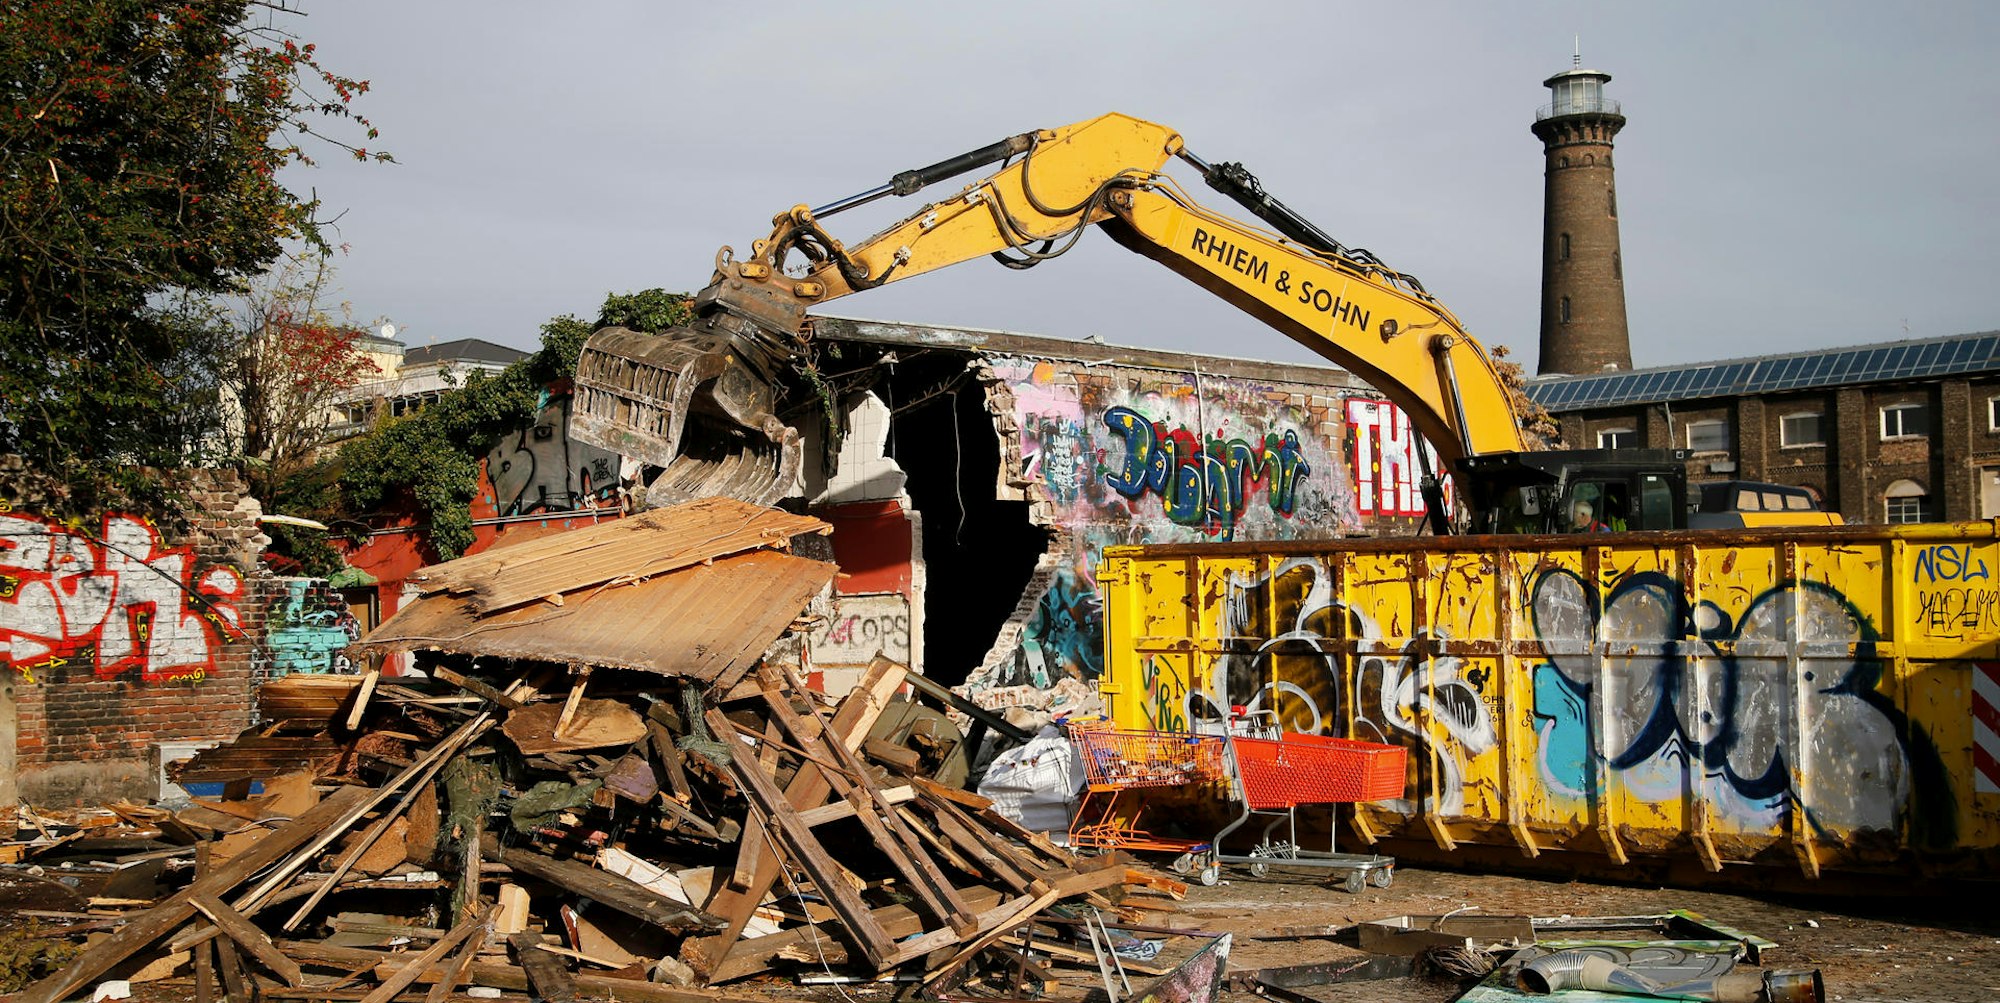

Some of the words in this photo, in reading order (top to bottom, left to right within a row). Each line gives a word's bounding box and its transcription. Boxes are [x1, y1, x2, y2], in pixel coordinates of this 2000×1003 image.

[1191, 227, 1270, 285] RHIEM
[1274, 270, 1291, 296] &
[1298, 280, 1371, 332] SOHN
[848, 614, 909, 649] COPS
